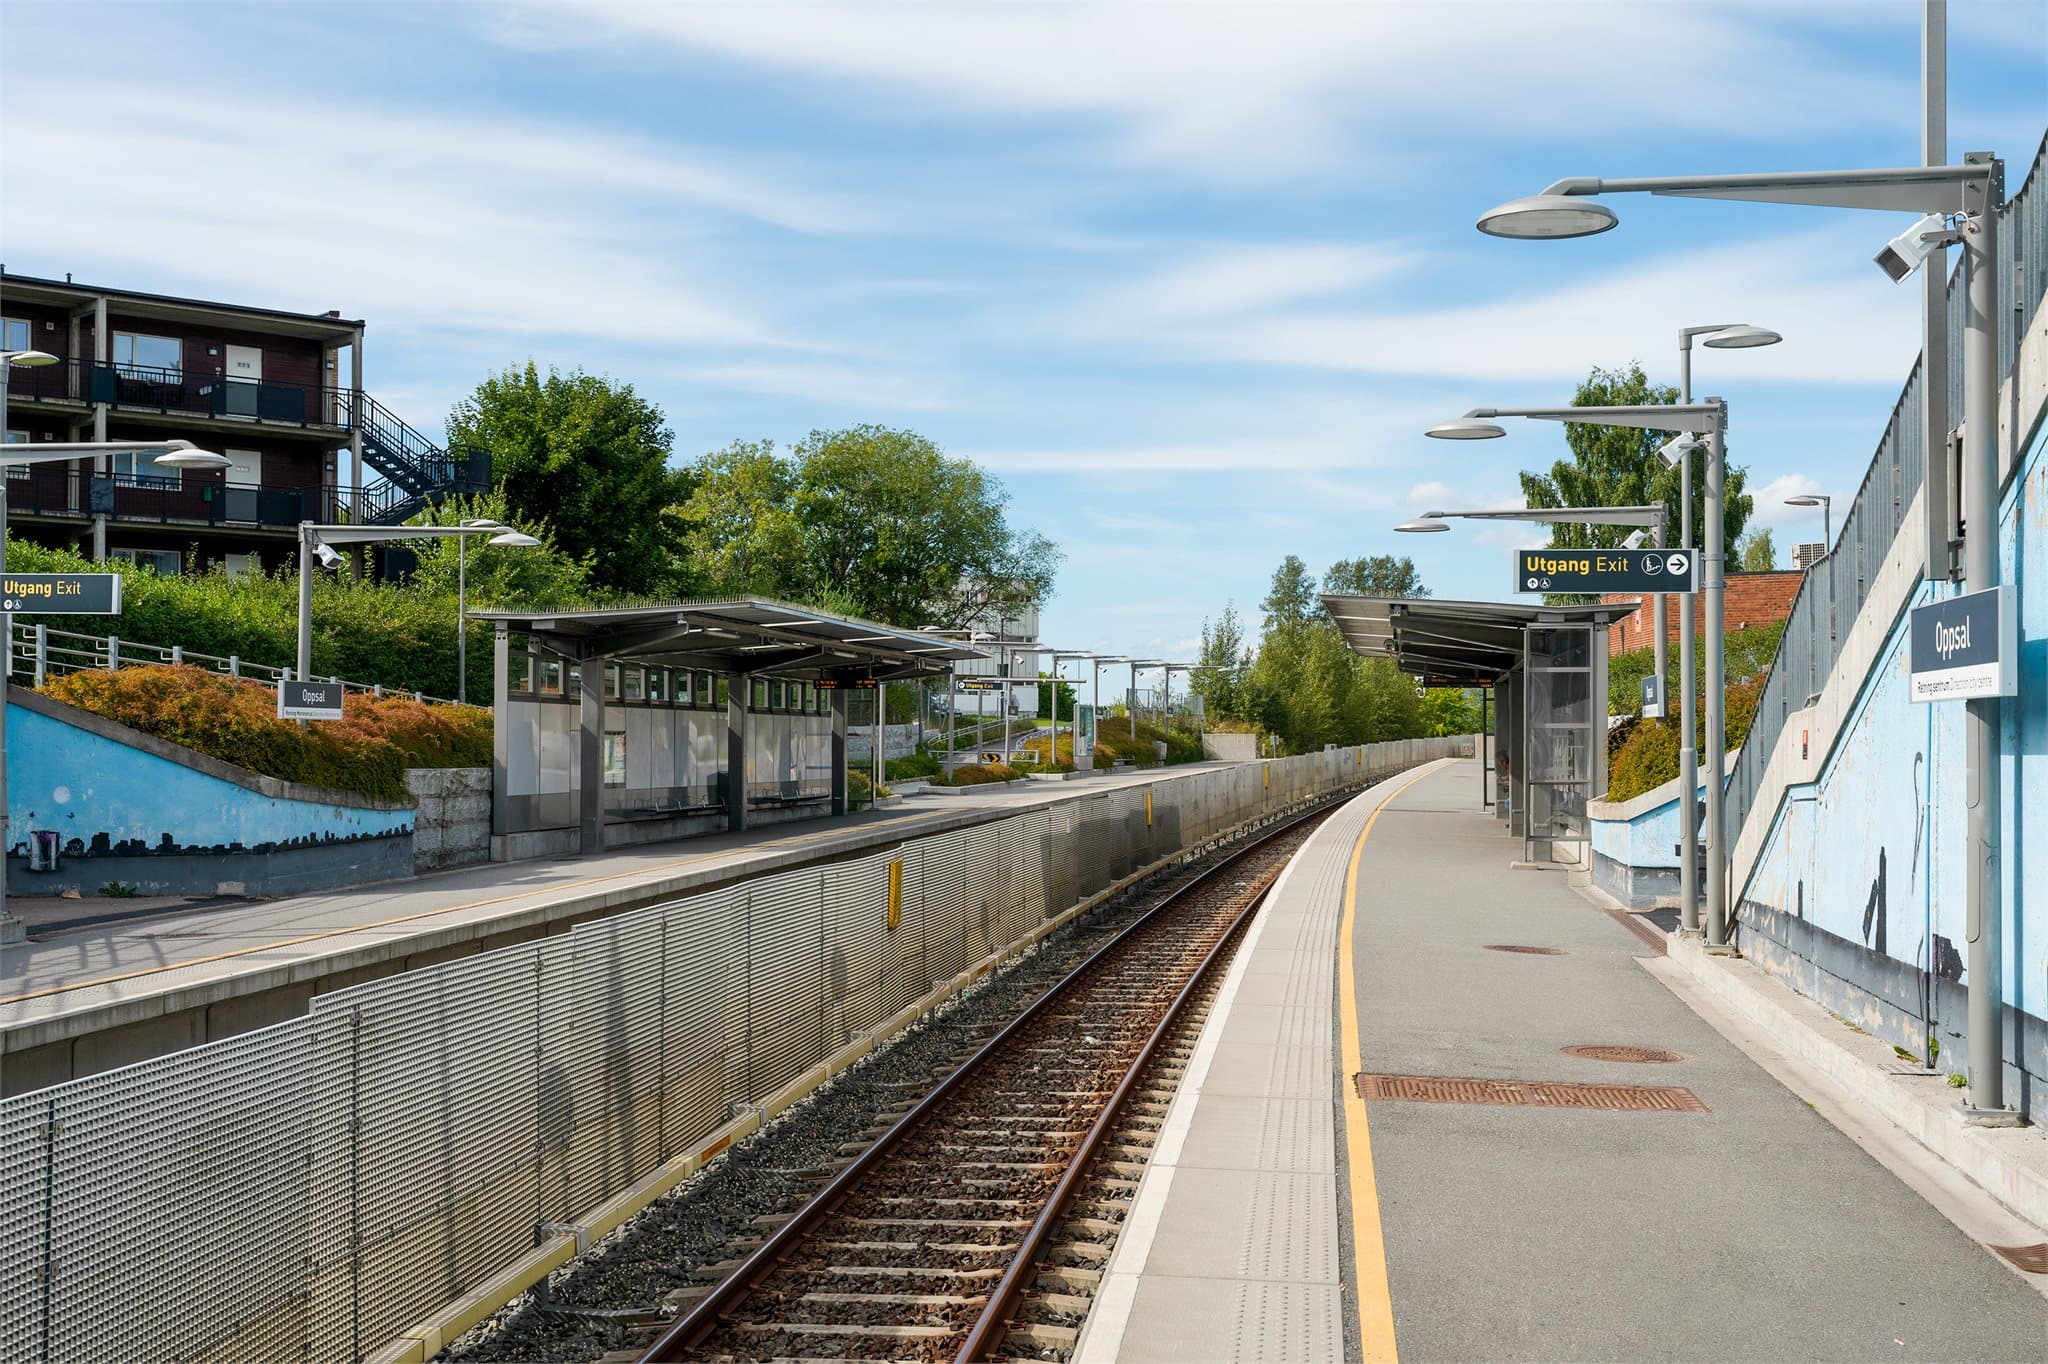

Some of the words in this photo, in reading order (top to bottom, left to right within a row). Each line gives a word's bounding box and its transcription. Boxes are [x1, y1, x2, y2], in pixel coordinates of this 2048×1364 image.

[1527, 556, 1590, 575] Utgang
[1597, 556, 1629, 572] Exit
[4, 580, 52, 598] Utgang
[56, 580, 81, 595] Exit
[1935, 615, 1971, 661] Oppsal
[302, 688, 325, 705] Oppsal
